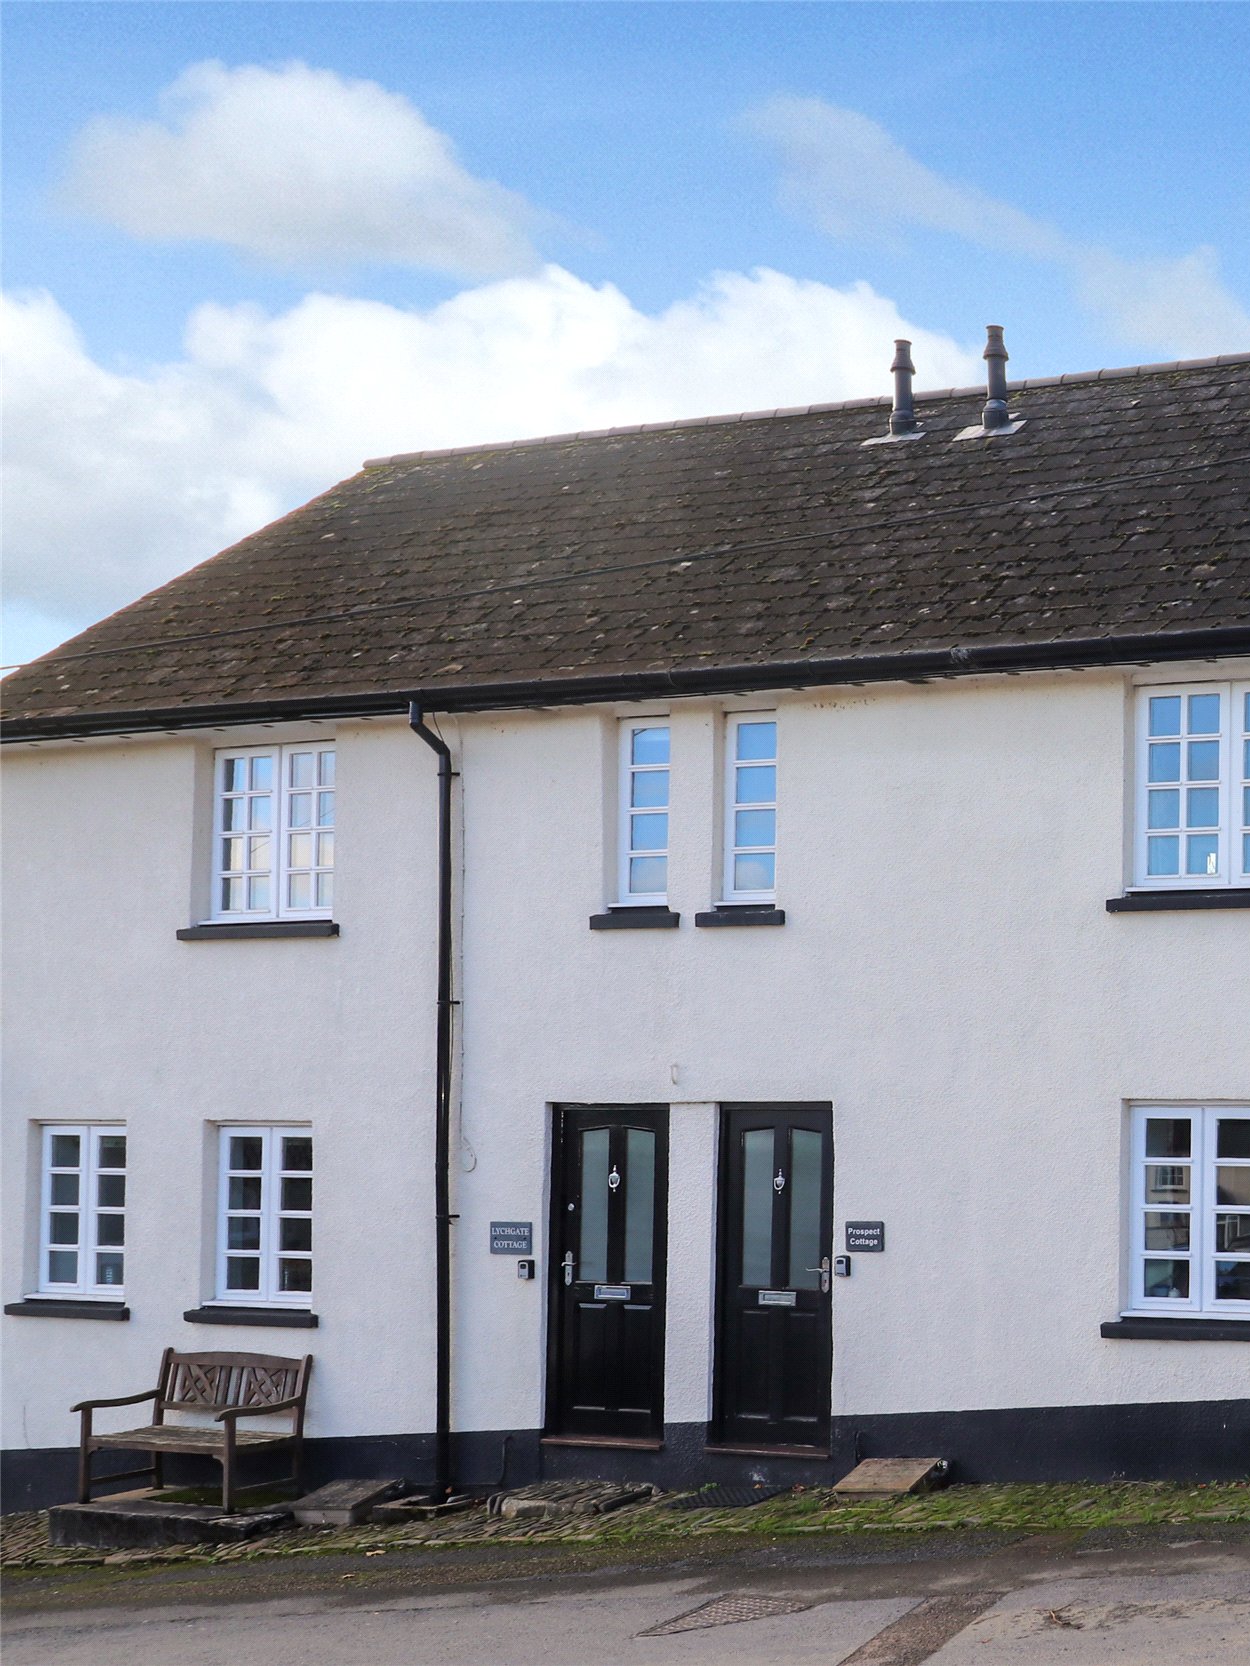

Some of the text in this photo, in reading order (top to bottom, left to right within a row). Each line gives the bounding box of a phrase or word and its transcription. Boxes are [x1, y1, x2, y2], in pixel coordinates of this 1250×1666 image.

[491, 1227, 530, 1236] LYCHGATE
[847, 1227, 880, 1236] Prospect
[493, 1240, 528, 1249] COTTAGE
[849, 1237, 878, 1247] Cottage
